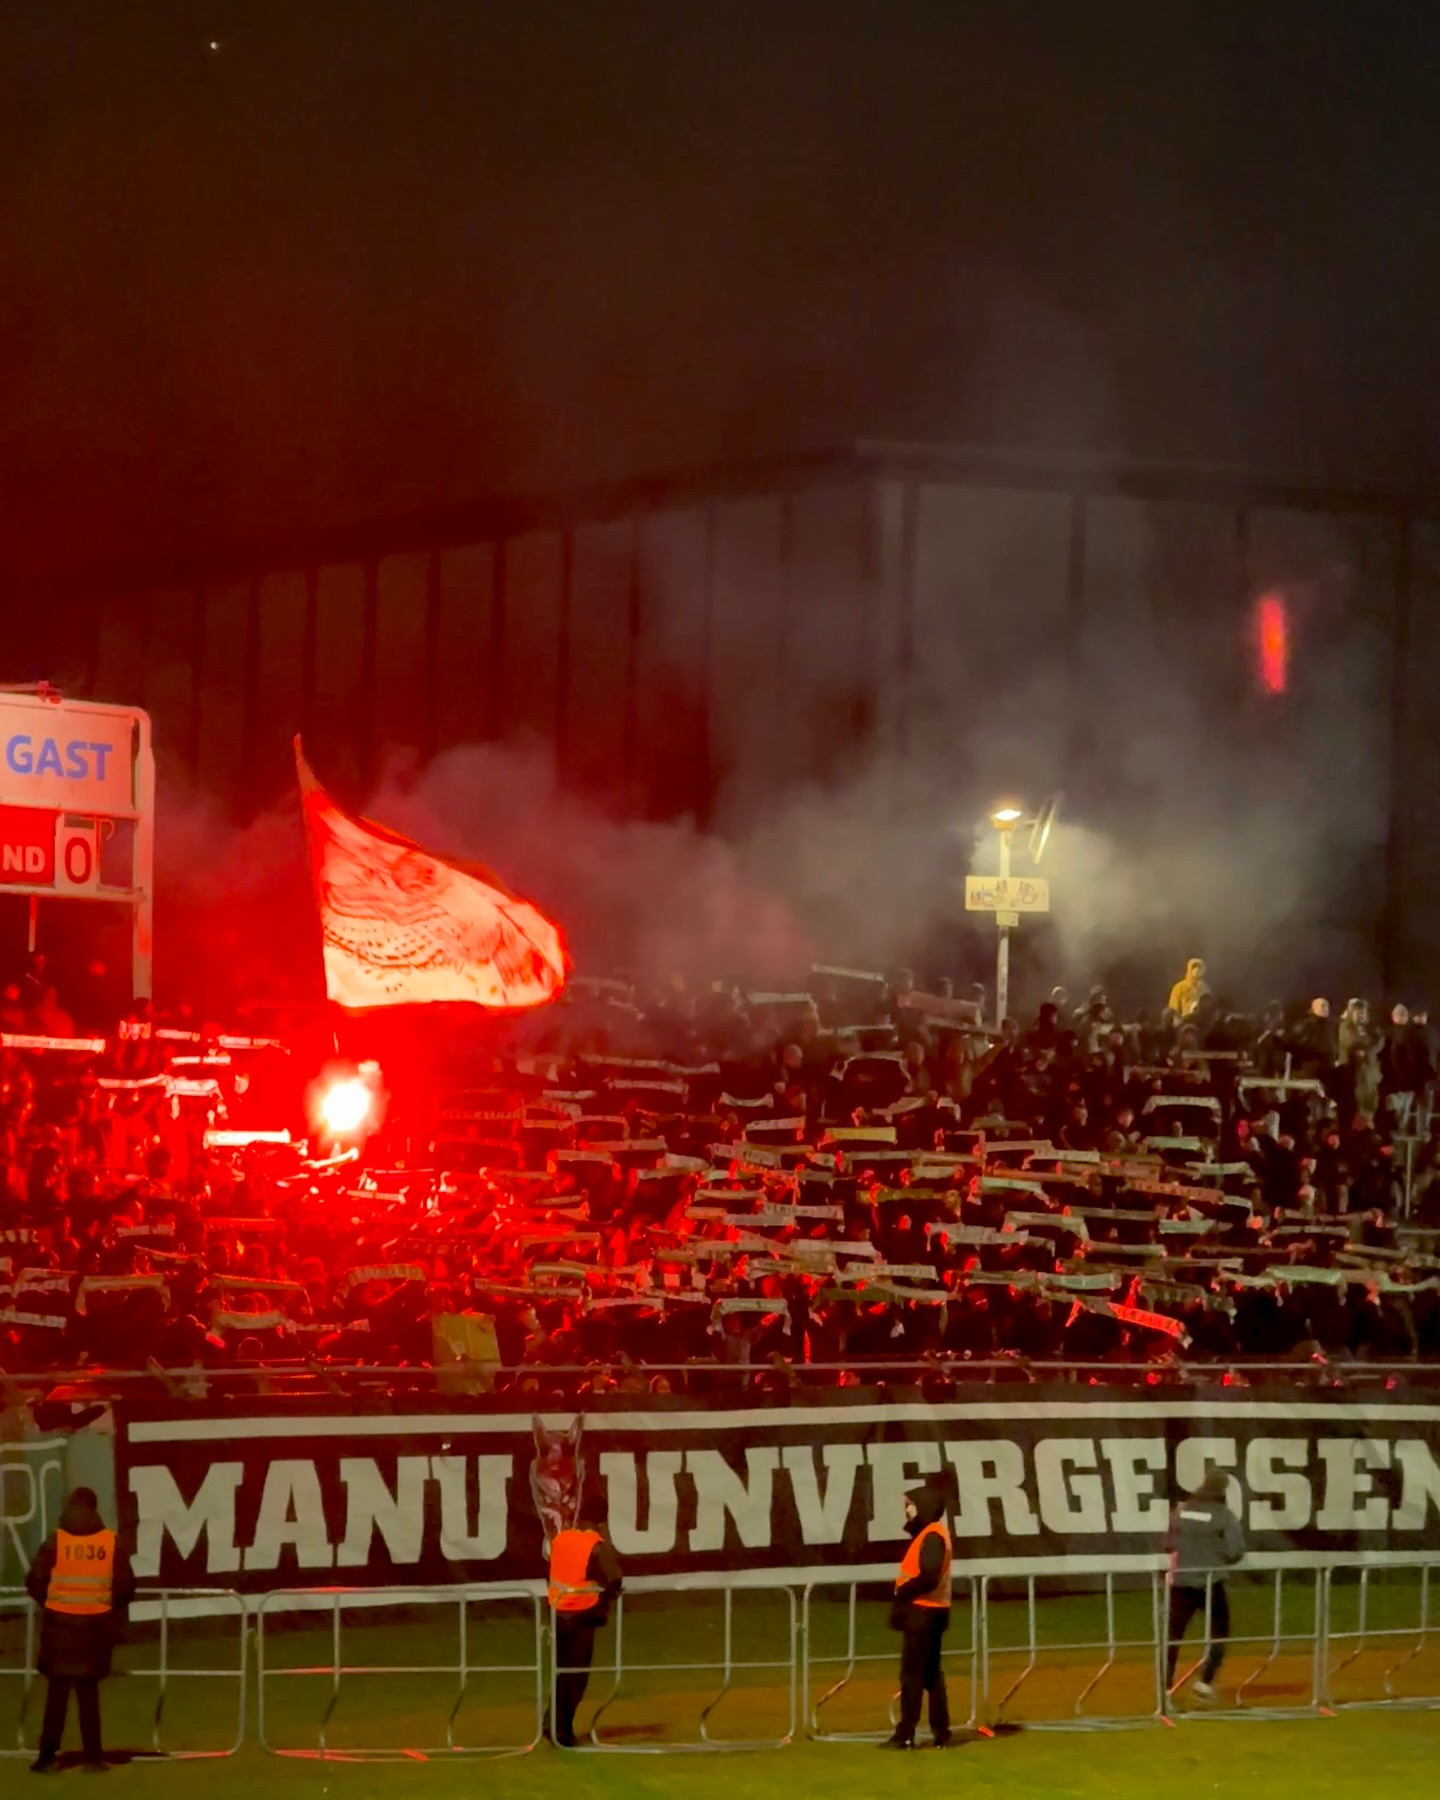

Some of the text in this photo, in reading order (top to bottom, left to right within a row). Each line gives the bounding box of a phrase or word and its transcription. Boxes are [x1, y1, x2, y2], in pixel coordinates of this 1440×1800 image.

[6, 735, 113, 781] GAST
[2, 844, 46, 874] ND
[64, 836, 92, 885] 0
[129, 1455, 513, 1577] MANU
[63, 1543, 107, 1562] 1036
